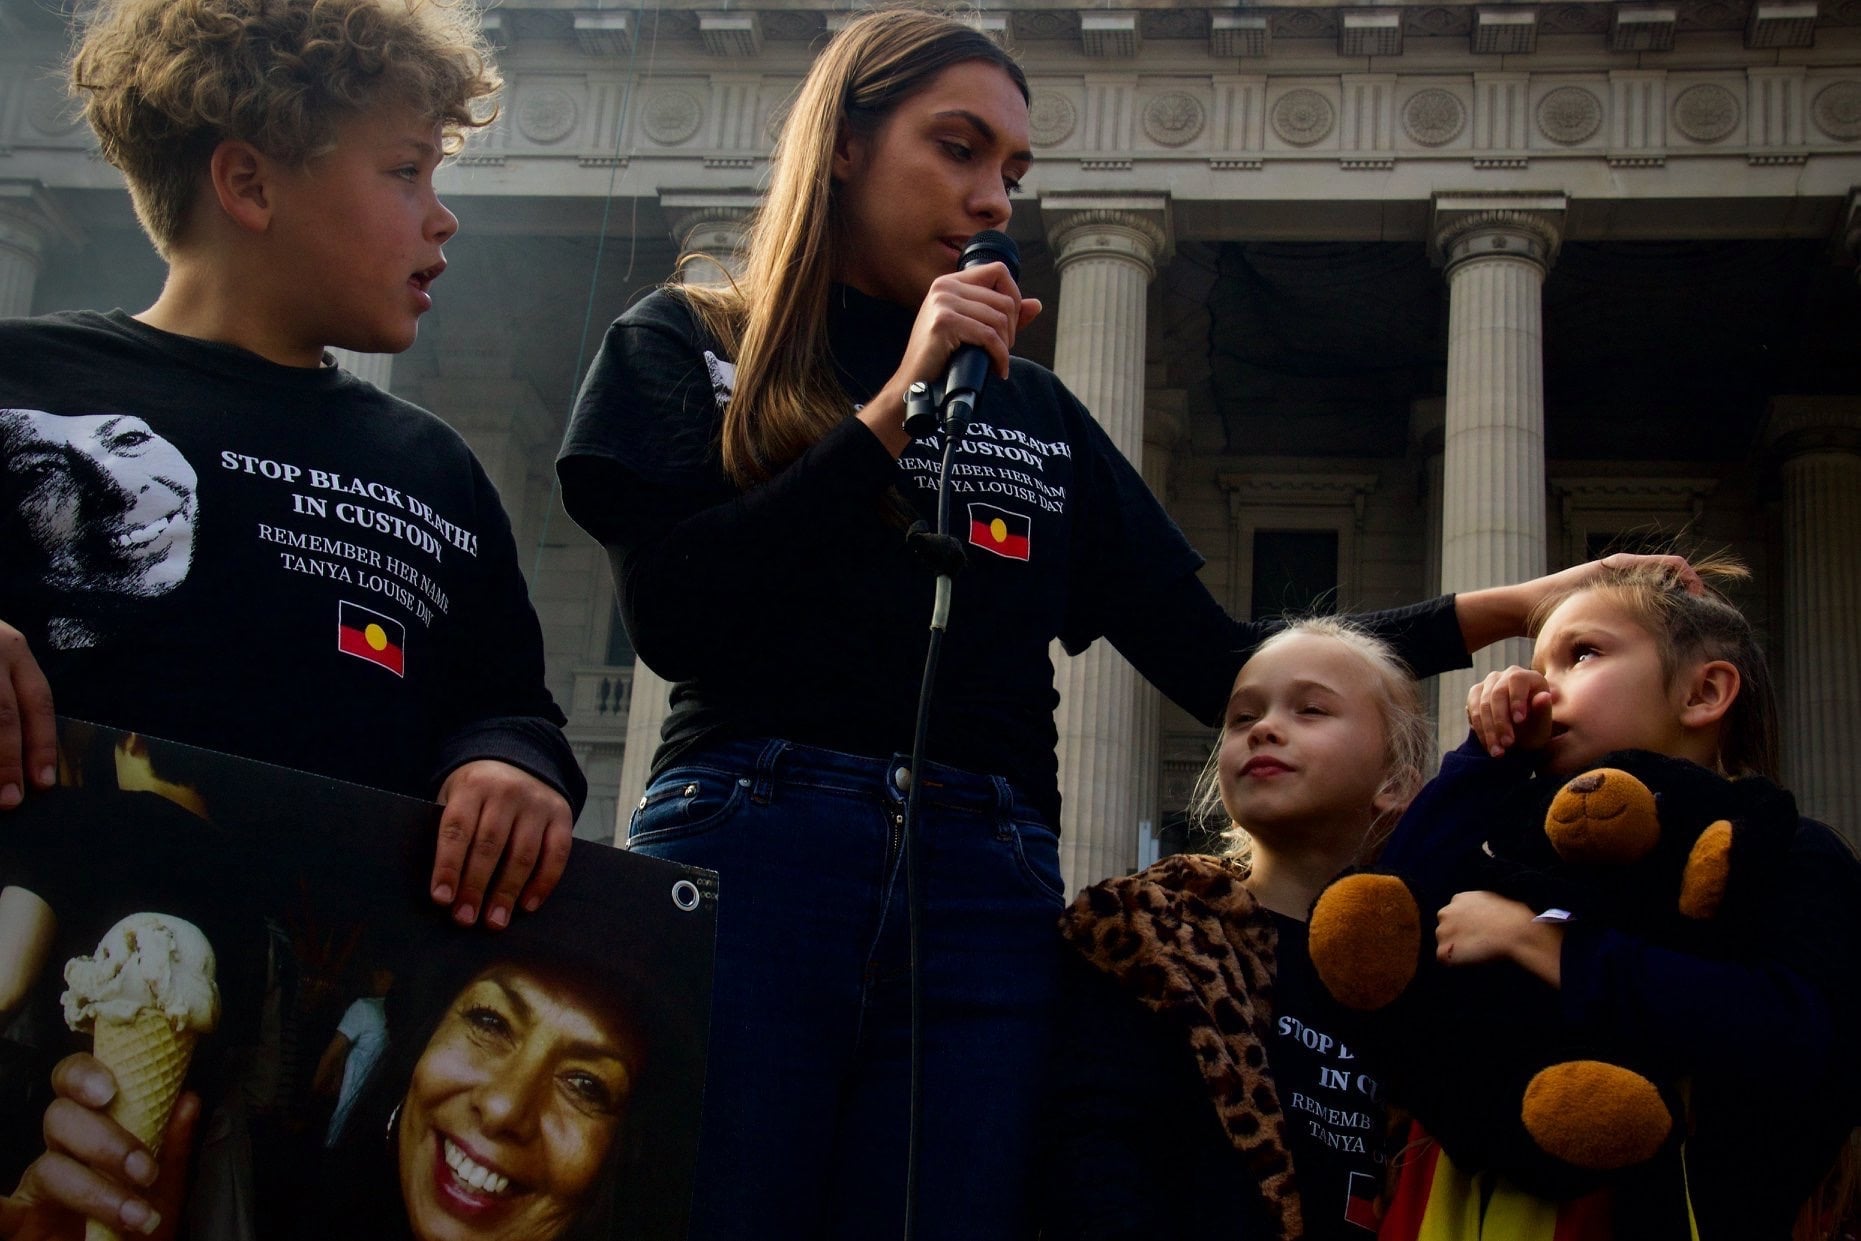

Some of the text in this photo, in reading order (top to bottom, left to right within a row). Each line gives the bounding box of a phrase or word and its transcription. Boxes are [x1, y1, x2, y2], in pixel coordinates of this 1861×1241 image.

[954, 438, 1044, 473] USTODY
[977, 481, 1037, 504] LOUISE
[1039, 494, 1064, 514] DAY
[997, 467, 1033, 487] HER
[1033, 478, 1067, 500] NAM
[221, 450, 478, 557] STOP BLACK DEATHS
[292, 493, 442, 563] IN CUSTODY
[257, 523, 449, 615] REMEMBER HER NAME
[281, 553, 352, 583] TANYA
[357, 570, 414, 612] LOUISE
[1277, 1015, 1334, 1054] STOP
[1318, 1066, 1351, 1091] IN
[1291, 1091, 1372, 1130] REMEMB
[1308, 1121, 1366, 1153] TANYA
